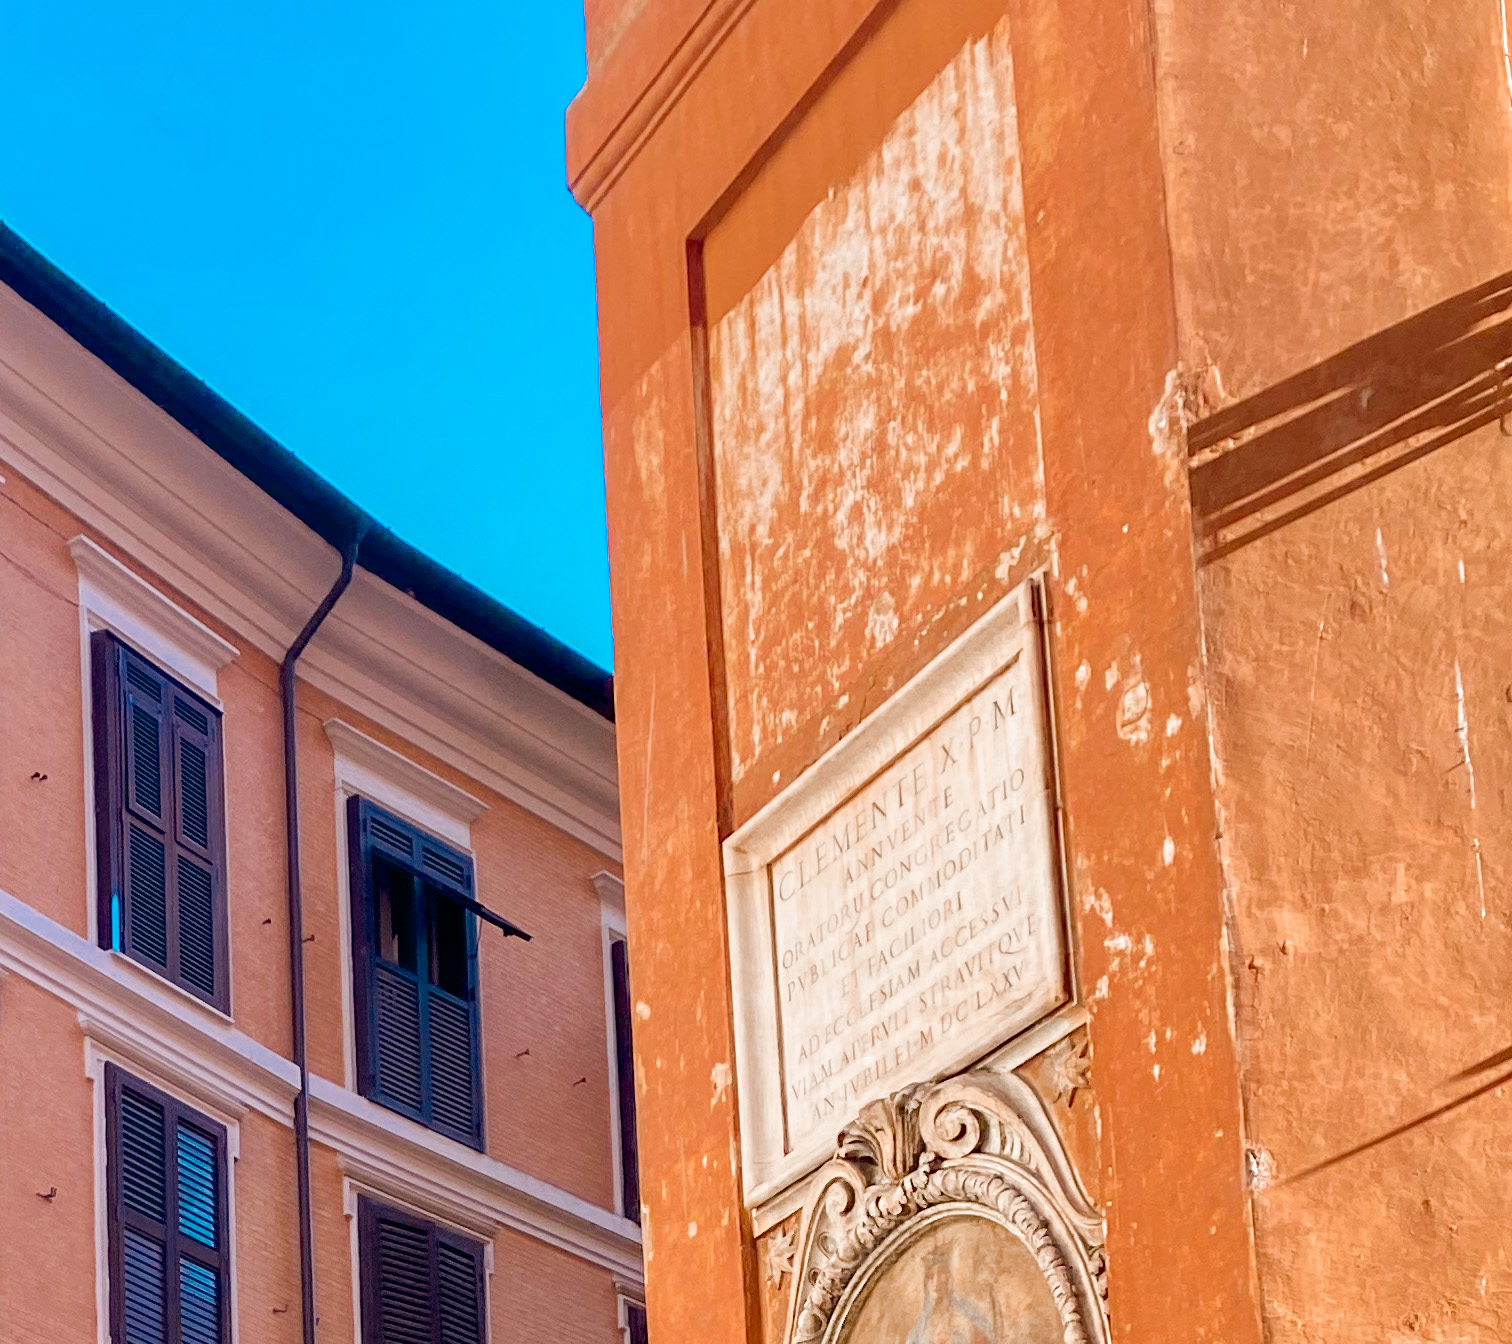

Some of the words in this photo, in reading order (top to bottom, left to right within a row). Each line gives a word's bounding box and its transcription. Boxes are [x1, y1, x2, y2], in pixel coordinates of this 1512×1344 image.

[779, 762, 927, 902] CLEMENTE
[844, 785, 954, 884] ANNVENTE
[870, 767, 1025, 901] CONGREGATIO
[787, 921, 874, 1002] PVBLICAE
[881, 804, 1025, 928] COMMODITATI
[841, 969, 859, 998] ET
[867, 891, 963, 977] FACILIORI
[798, 1034, 821, 1065] AD
